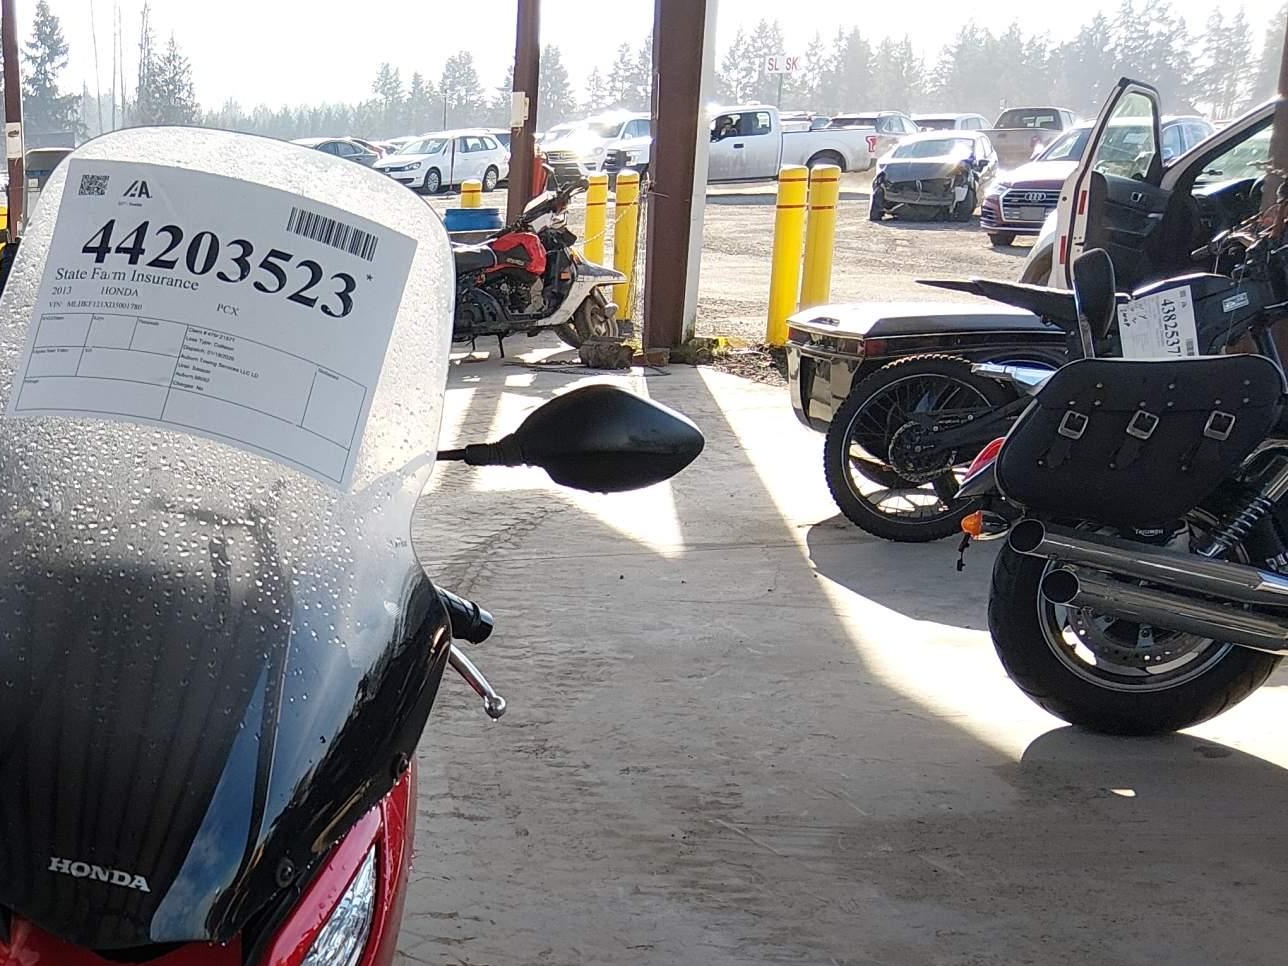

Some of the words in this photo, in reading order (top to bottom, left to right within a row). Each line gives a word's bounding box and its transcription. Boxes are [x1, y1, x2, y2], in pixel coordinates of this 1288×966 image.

[768, 57, 780, 71] SL
[55, 267, 87, 280] State
[91, 267, 126, 280] Farm
[130, 269, 200, 291] Insurance
[51, 286, 72, 296] 2013
[100, 286, 139, 297] HONDA
[217, 303, 239, 316] PCX
[48, 857, 151, 892] HONDA
